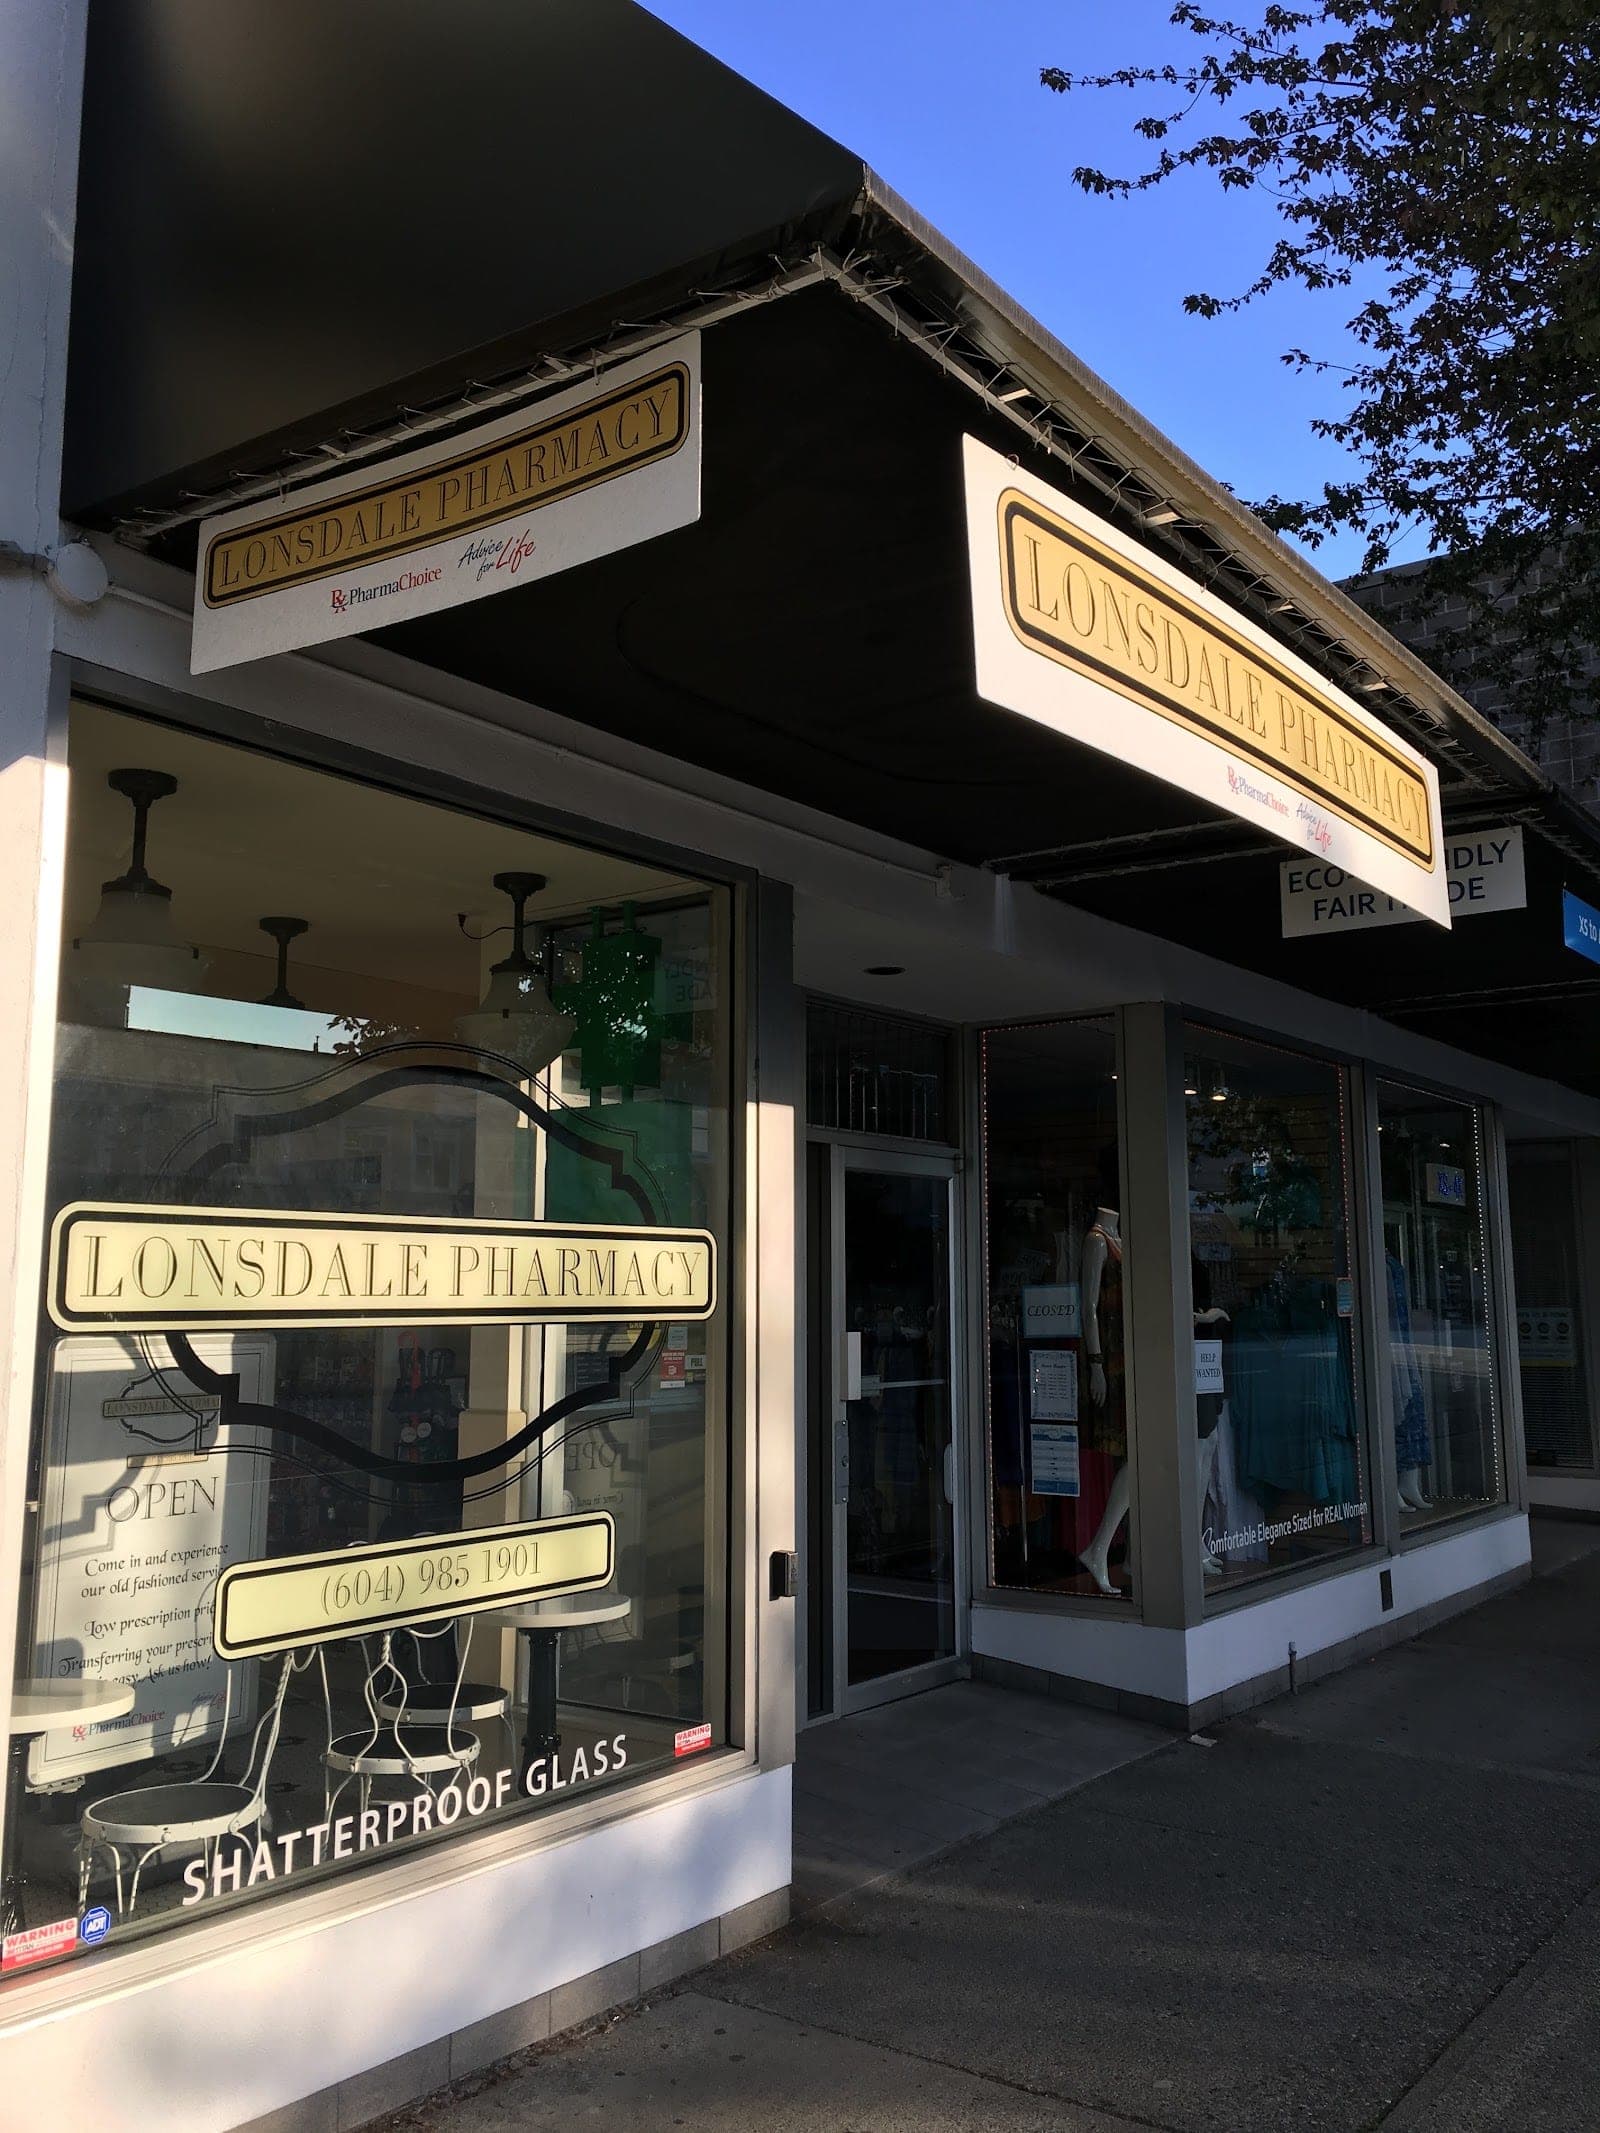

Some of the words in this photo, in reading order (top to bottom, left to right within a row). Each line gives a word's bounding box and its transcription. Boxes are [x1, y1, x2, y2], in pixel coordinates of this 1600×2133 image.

[218, 490, 423, 589] LONSDALE
[436, 386, 674, 521] PHARMACY
[457, 539, 504, 568] Advice
[475, 558, 496, 581] for
[495, 528, 538, 574] Life
[1023, 534, 1268, 739] LONSDALE
[1274, 688, 1426, 841] PHARMACY
[1314, 820, 1333, 852] Life
[1313, 892, 1376, 921] FAIR
[1588, 919, 1598, 942] to
[80, 1233, 429, 1299] LONSDALE
[448, 1243, 703, 1298] PHARMACY
[1027, 1304, 1075, 1318] CLOSED
[1194, 1367, 1221, 1378] WANTED
[1200, 1352, 1216, 1363] HELP
[105, 1475, 220, 1523] OPEN
[1201, 1526, 1257, 1555] Comfortable
[1257, 1521, 1292, 1545] Elegance
[1292, 1511, 1313, 1532] Sized
[1313, 1509, 1324, 1526] for
[1324, 1505, 1343, 1525] REAL
[1342, 1501, 1368, 1520] Women
[84, 1557, 126, 1577] Come
[130, 1555, 142, 1569] in
[145, 1550, 168, 1567] and
[170, 1542, 229, 1565] experience
[81, 1583, 106, 1599] our
[109, 1577, 129, 1595] old
[130, 1571, 190, 1598] fashioned
[320, 1563, 407, 1616] (604)
[417, 1555, 471, 1597] 985
[480, 1541, 541, 1586] 1901
[84, 1620, 118, 1641] Low
[120, 1608, 191, 1636] prescription
[58, 1644, 143, 1677] Transferring
[146, 1643, 174, 1664] your
[175, 1636, 214, 1654] prescri
[139, 1664, 166, 1684] Ask
[168, 1663, 181, 1676] us
[182, 1654, 213, 1673] how!
[88, 1710, 166, 1737] PharmaChoice
[677, 1724, 710, 1741] WARNING
[183, 1768, 512, 1907] SHATTERPROOF
[525, 1733, 629, 1799] GLASS
[6, 1920, 75, 1948] WARNING
[86, 1916, 107, 1933] ADT
